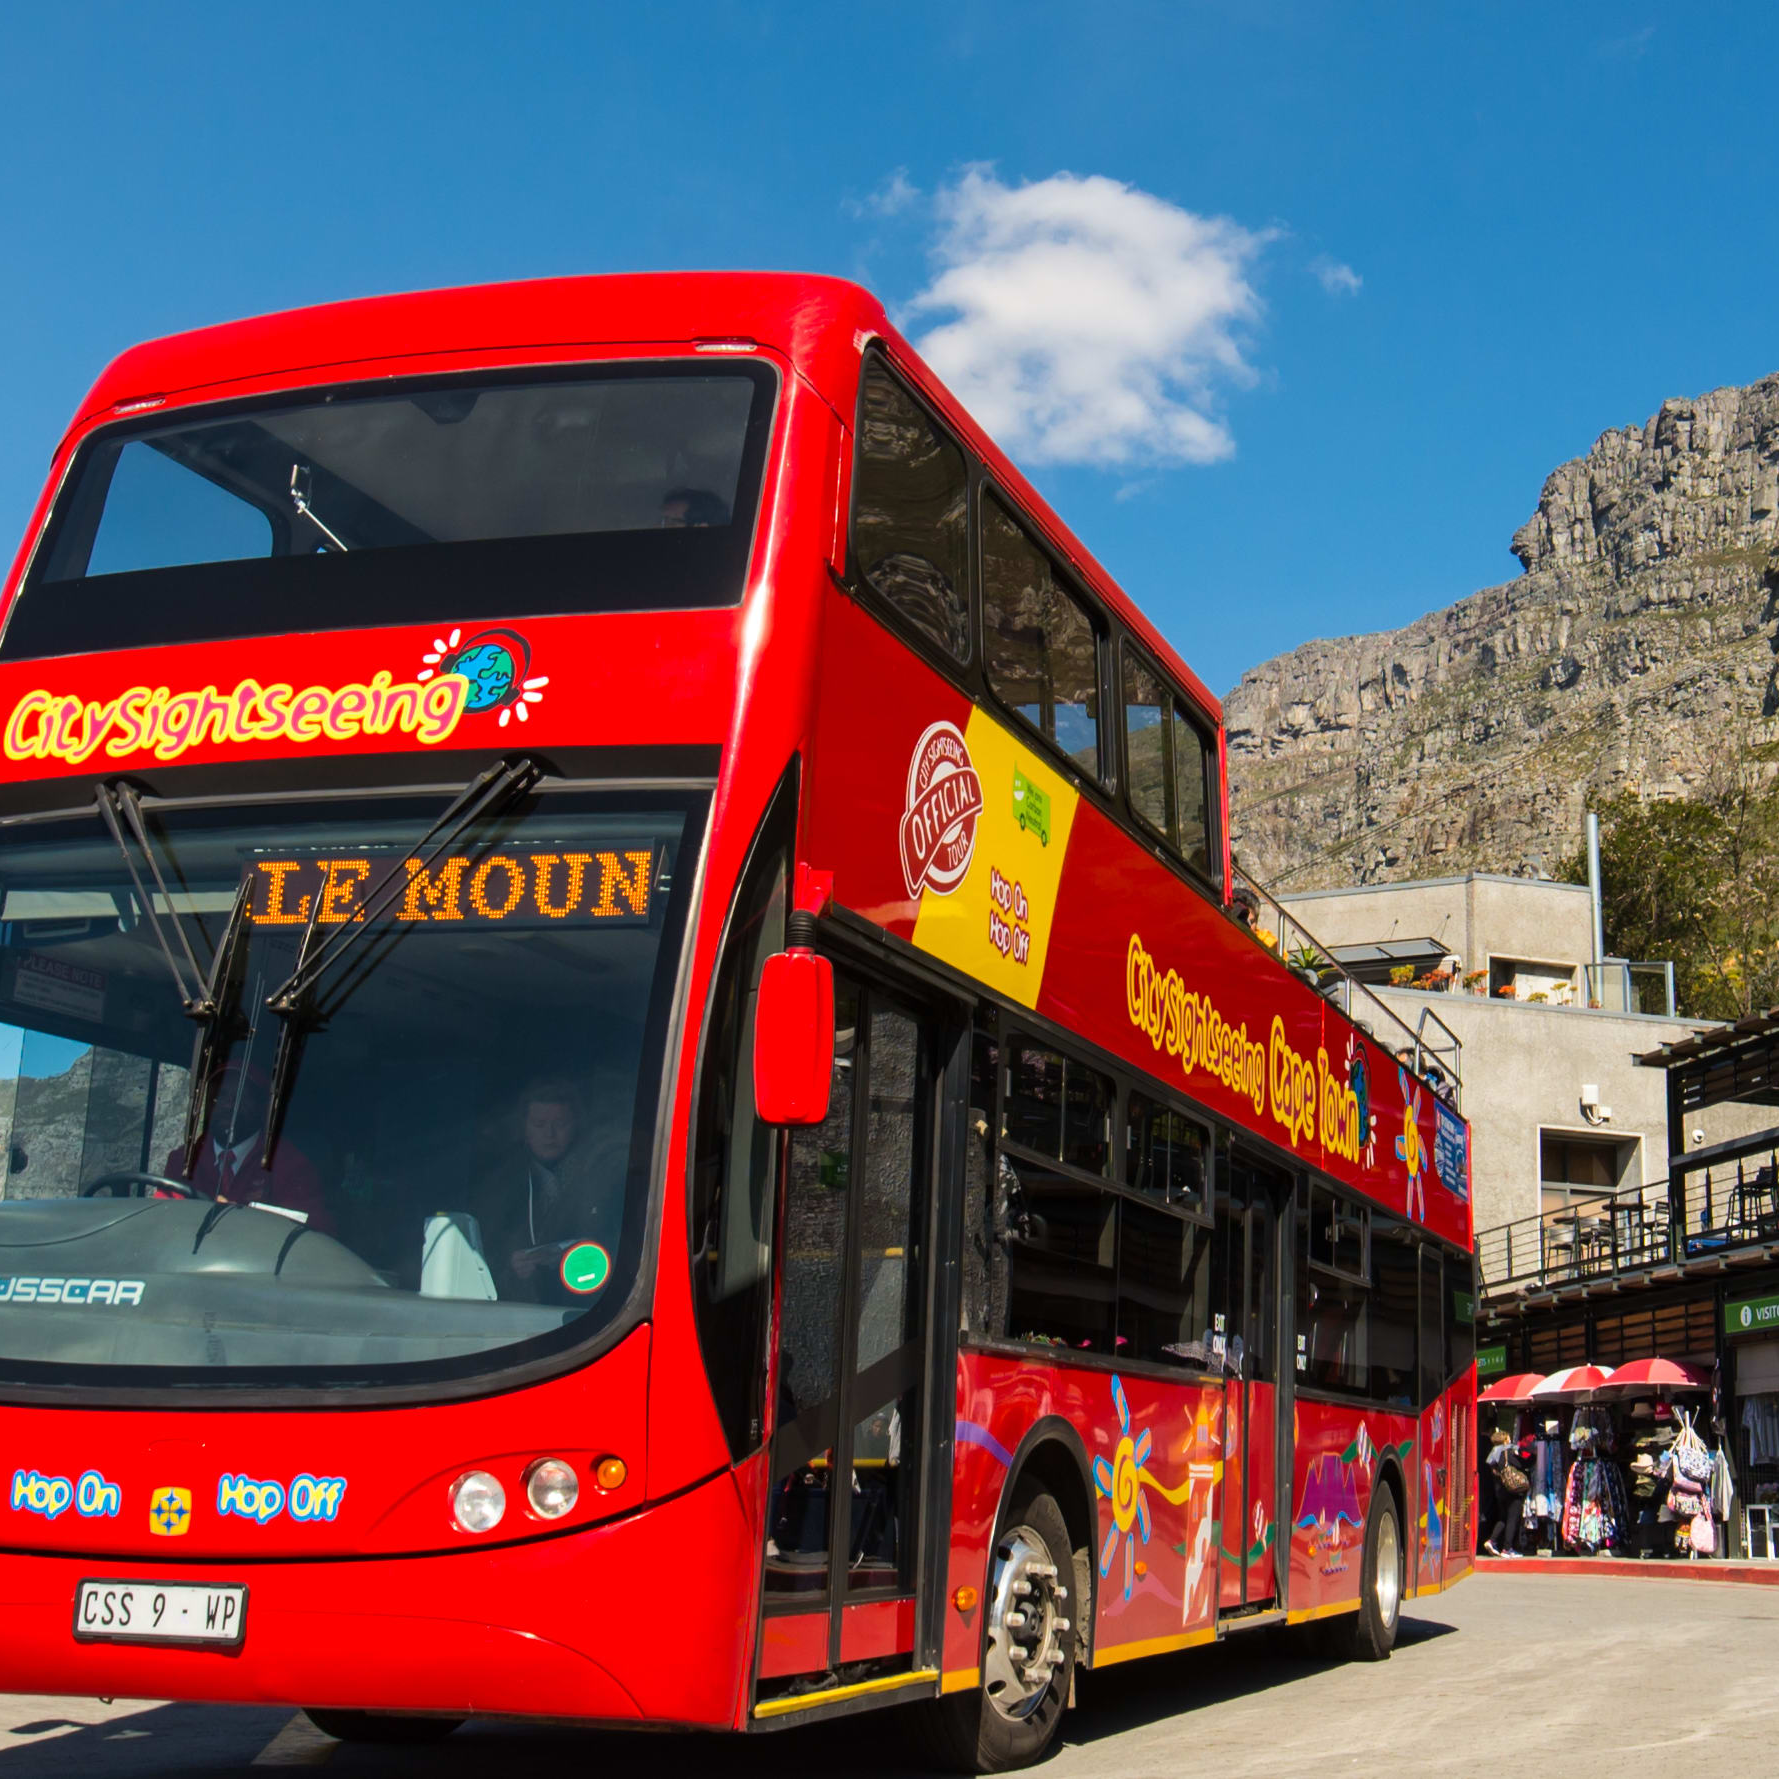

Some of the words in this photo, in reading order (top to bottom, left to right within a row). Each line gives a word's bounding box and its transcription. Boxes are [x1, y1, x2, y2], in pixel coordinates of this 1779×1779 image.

[4, 671, 470, 764] CitySightseeing
[919, 759, 931, 789] CITY
[927, 737, 964, 767] SIGHTSEEING
[911, 775, 976, 860] OFFICIAL
[947, 830, 969, 869] TOUR
[990, 865, 1012, 915] Hop
[1014, 881, 1028, 923] On
[989, 910, 1011, 959] Hop
[1012, 924, 1030, 966] Off
[1127, 933, 1265, 1116] CitySightseeing
[1270, 1014, 1316, 1148] Cape
[1317, 1047, 1360, 1164] Town
[10, 1468, 72, 1521] Hop
[75, 1469, 122, 1518] On
[216, 1472, 286, 1525] Hop
[288, 1472, 347, 1522] Off
[83, 1590, 134, 1627] CSS
[152, 1592, 166, 1628] 9
[205, 1594, 236, 1631] WP
